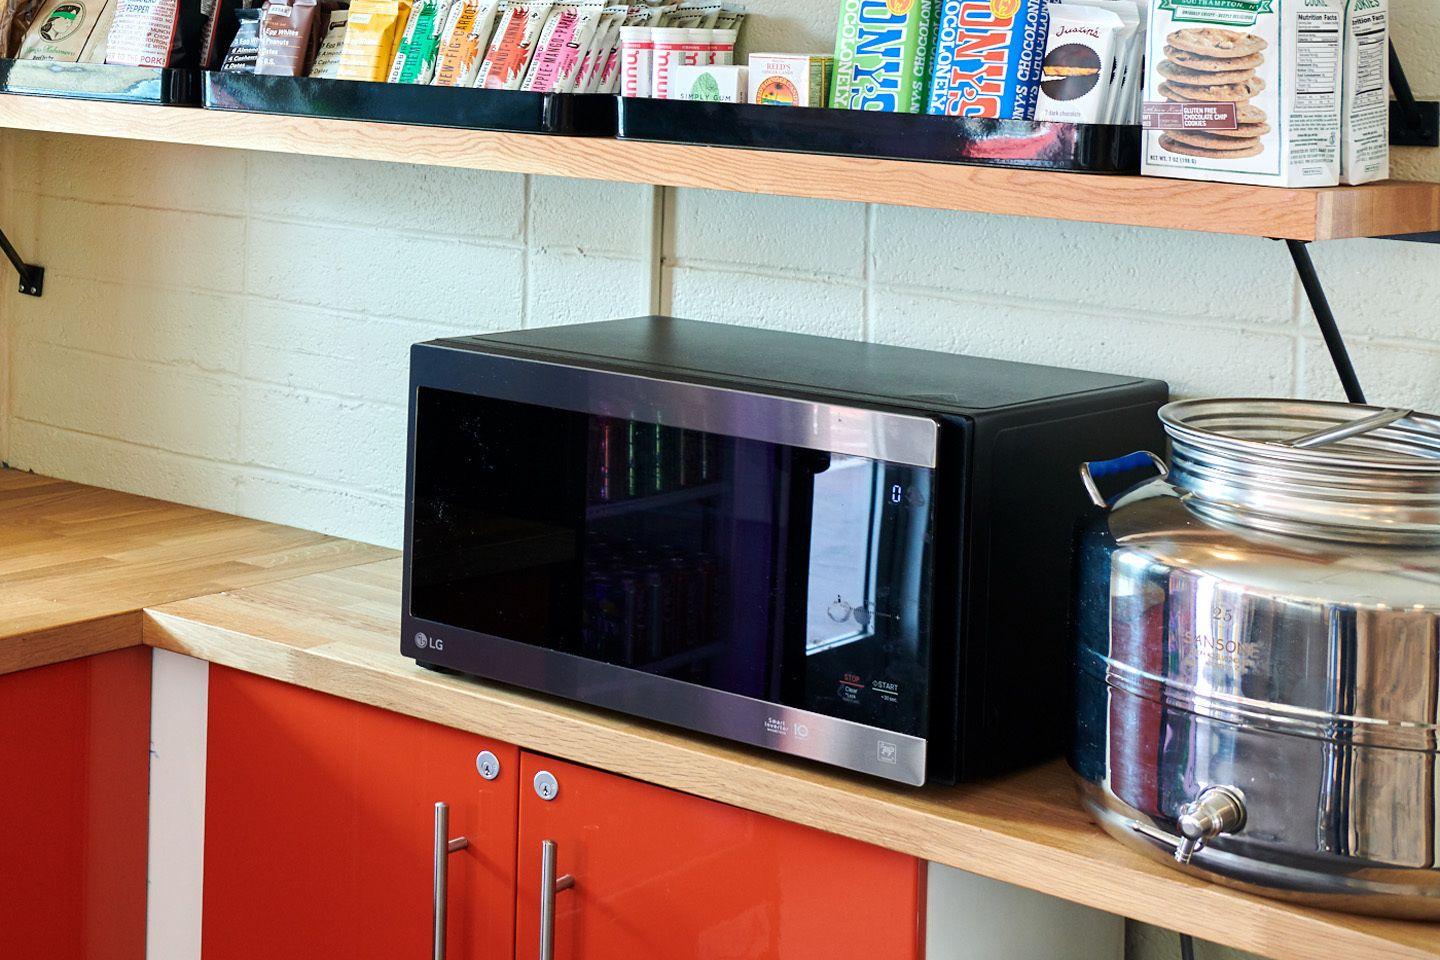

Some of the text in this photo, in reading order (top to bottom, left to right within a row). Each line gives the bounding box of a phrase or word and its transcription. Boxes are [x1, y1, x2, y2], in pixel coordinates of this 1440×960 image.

[1055, 25, 1101, 39] Justin's
[543, 38, 565, 63] MANGO
[1212, 606, 1233, 622] 25
[428, 637, 444, 653] LG
[1185, 631, 1262, 659] SANSONE
[844, 673, 860, 682] STOP
[878, 681, 898, 690] START
